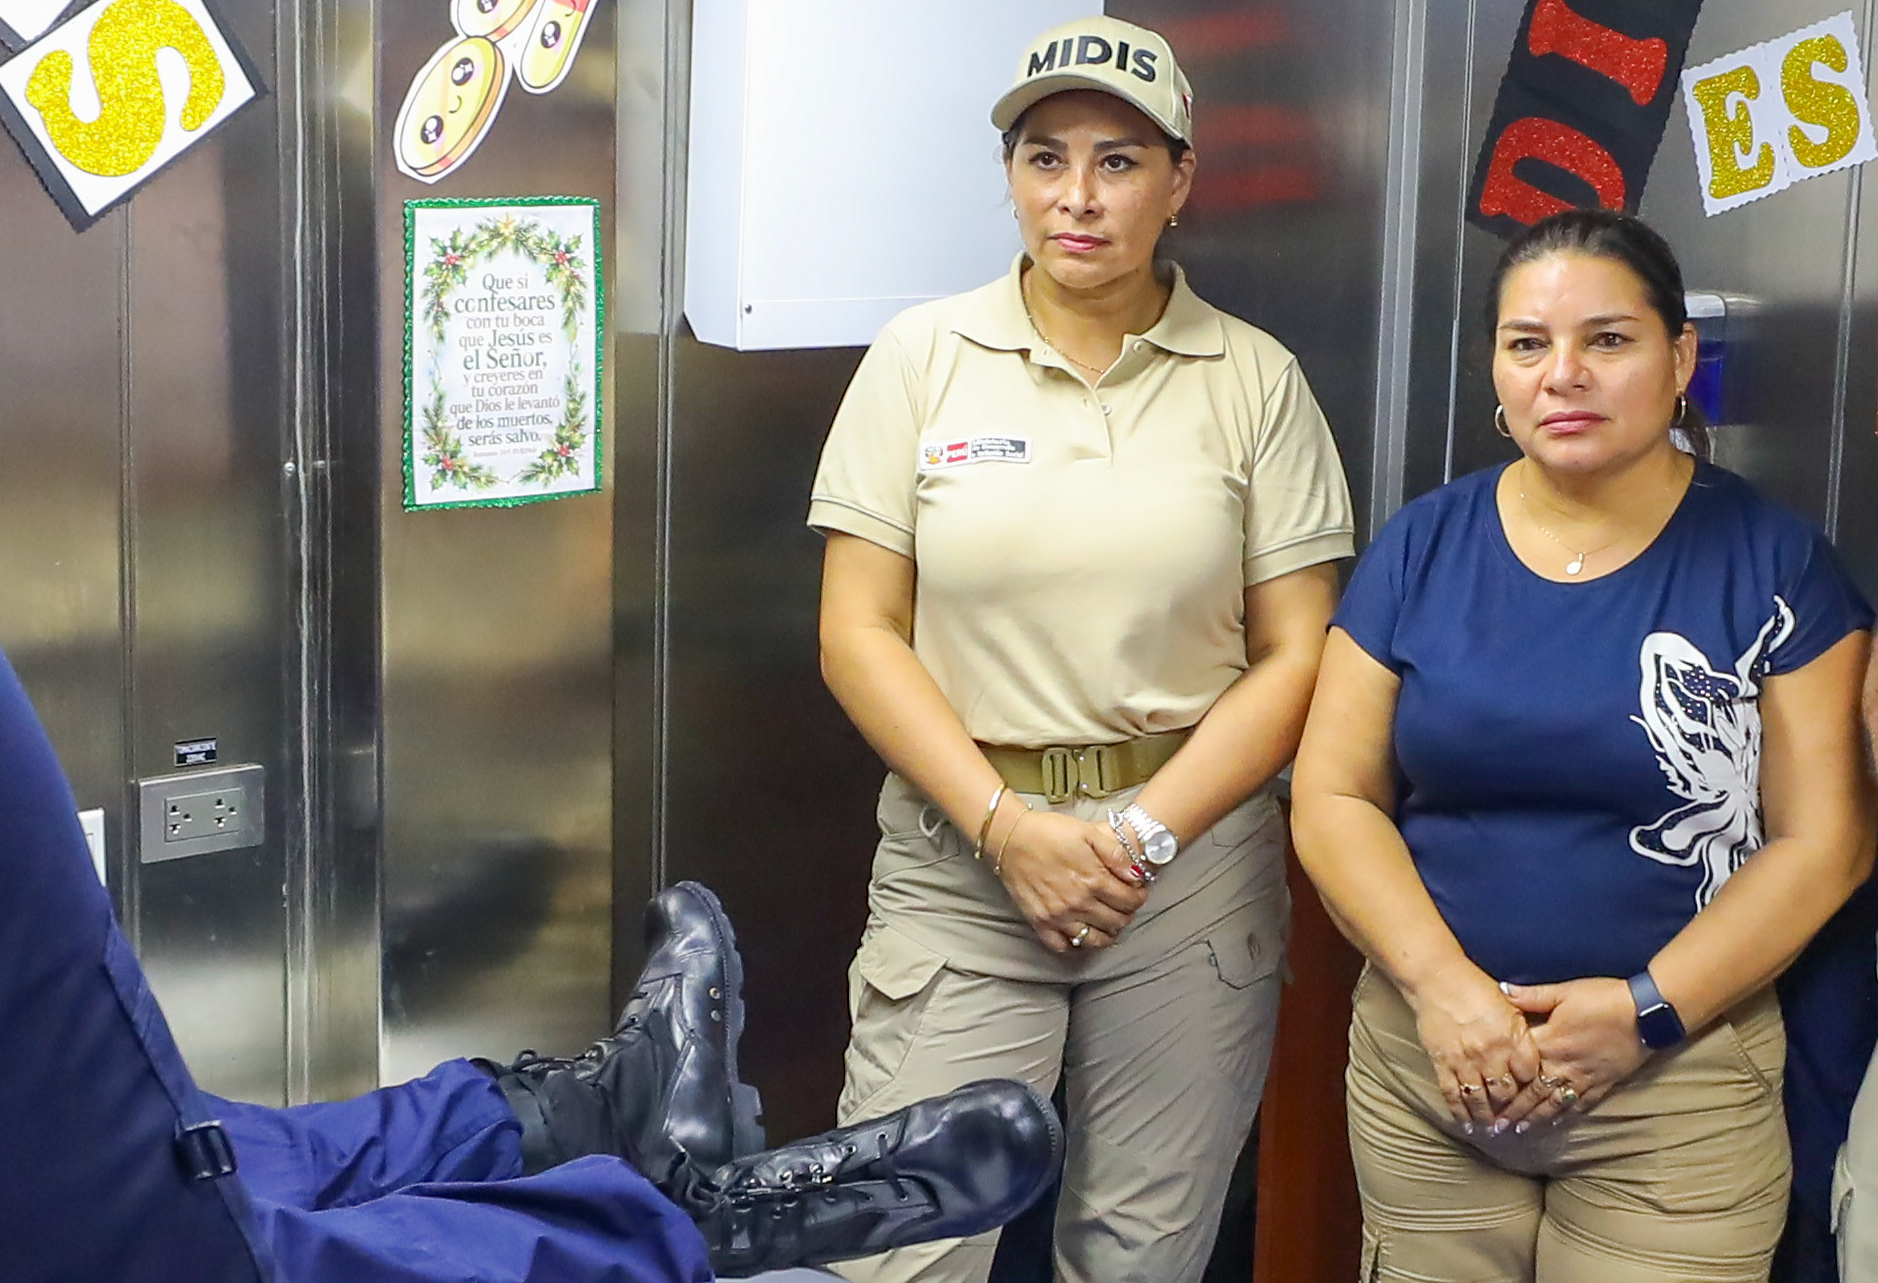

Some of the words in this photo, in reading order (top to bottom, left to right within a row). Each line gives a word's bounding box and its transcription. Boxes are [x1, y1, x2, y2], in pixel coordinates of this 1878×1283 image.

[1027, 35, 1158, 83] MIDIS
[1692, 33, 1861, 199] ES
[482, 273, 513, 294] Que
[517, 272, 529, 289] si
[454, 292, 556, 313] confesares
[466, 317, 491, 329] con
[495, 315, 509, 328] tu
[513, 313, 545, 327] boca
[459, 335, 484, 351] que
[488, 328, 535, 348] Jesús
[538, 332, 553, 344] es
[463, 349, 480, 370] el
[486, 348, 547, 369] Señor,
[463, 373, 471, 387] y
[528, 369, 543, 380] en
[472, 386, 484, 398] tu
[488, 382, 538, 397] corazón
[450, 403, 472, 417] que
[475, 399, 502, 413] Dios
[505, 397, 515, 411] le
[517, 395, 560, 410] levantó
[456, 416, 473, 431] de
[476, 415, 494, 429] los
[468, 430, 502, 446] serás
